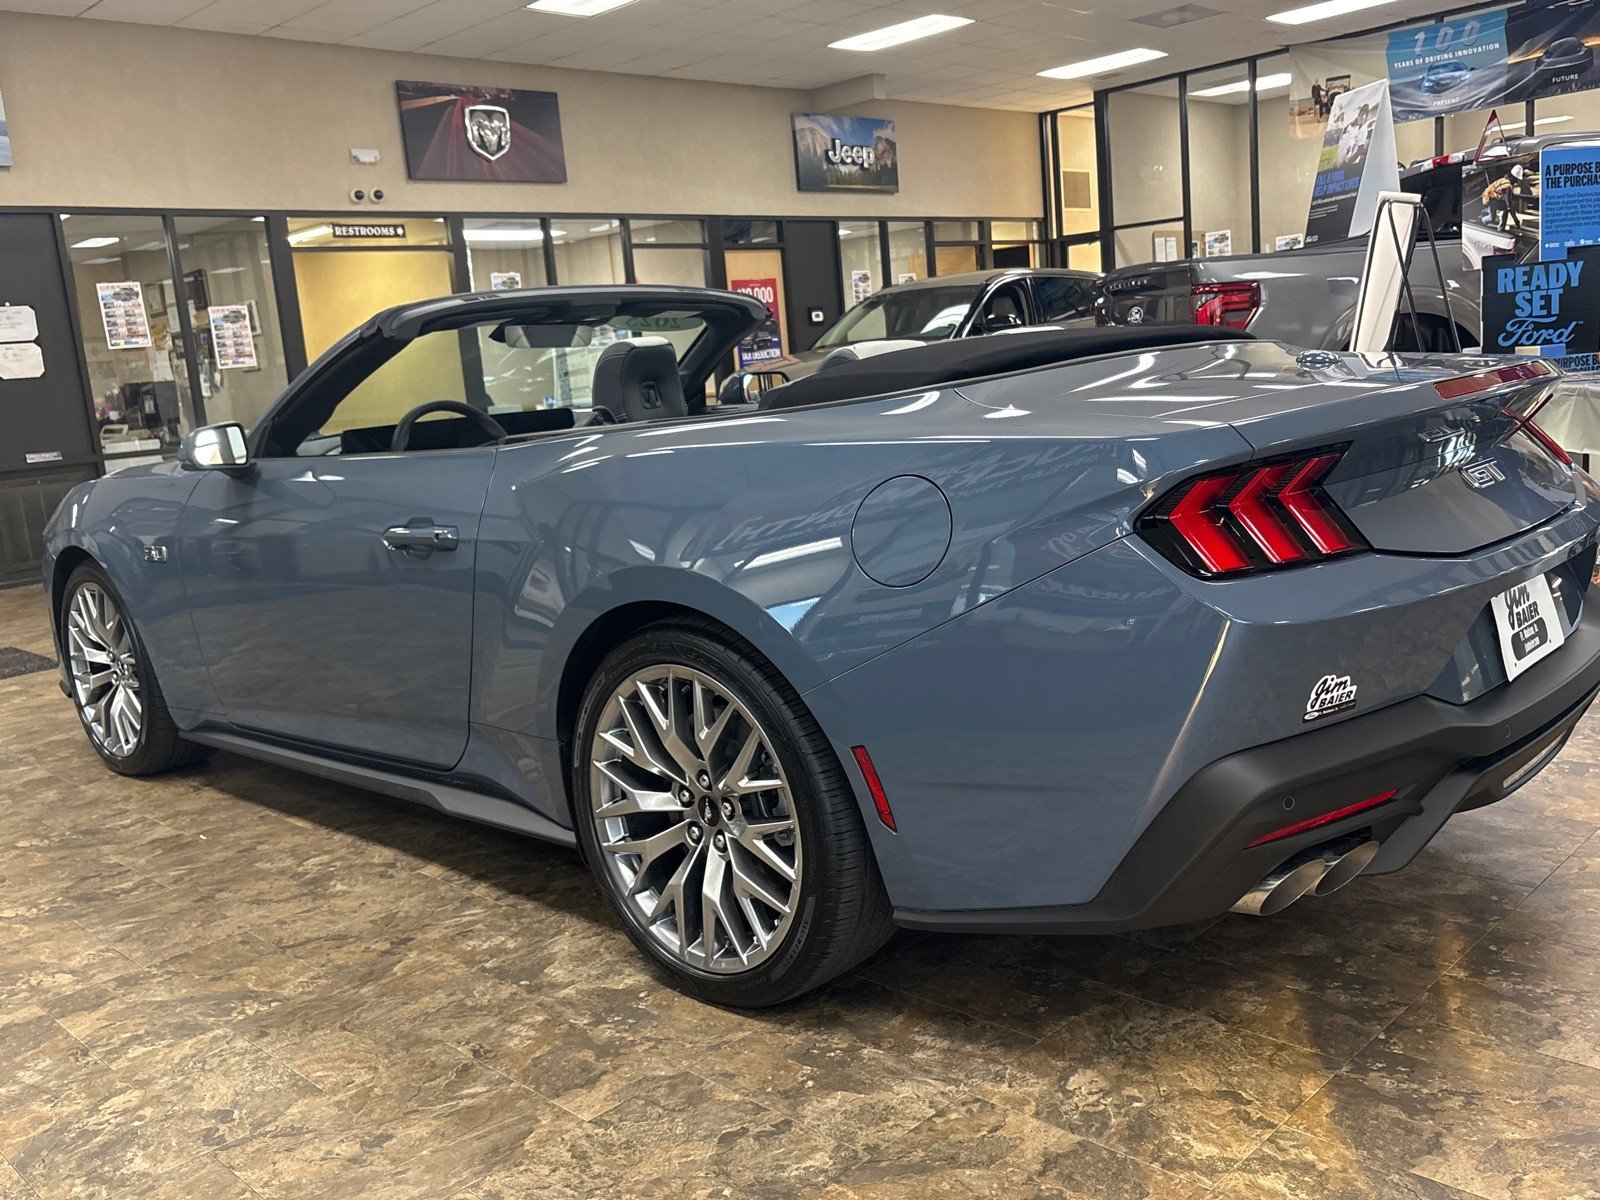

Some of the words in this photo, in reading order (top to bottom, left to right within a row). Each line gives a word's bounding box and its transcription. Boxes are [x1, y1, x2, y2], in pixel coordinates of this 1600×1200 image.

[1414, 20, 1480, 56] 100
[1394, 59, 1414, 69] YEARS
[1425, 53, 1454, 63] DRIVING
[1455, 42, 1500, 57] INNOVATION
[1552, 73, 1579, 83] FUTURE
[1433, 97, 1460, 107] PRESENT
[826, 139, 876, 168] Jeep
[1545, 165, 1552, 177] A
[1553, 161, 1594, 177] PURPOSE
[1545, 176, 1562, 190] THE
[1563, 173, 1600, 189] PURCHA
[334, 226, 395, 236] RESTROOMS
[1497, 260, 1584, 294] READY
[1514, 288, 1564, 318] SET
[1497, 316, 1577, 347] Ford
[1459, 456, 1506, 489] GT
[1515, 601, 1540, 629] BAIER
[1310, 677, 1349, 710] Jim
[1318, 690, 1354, 709] BAIER
